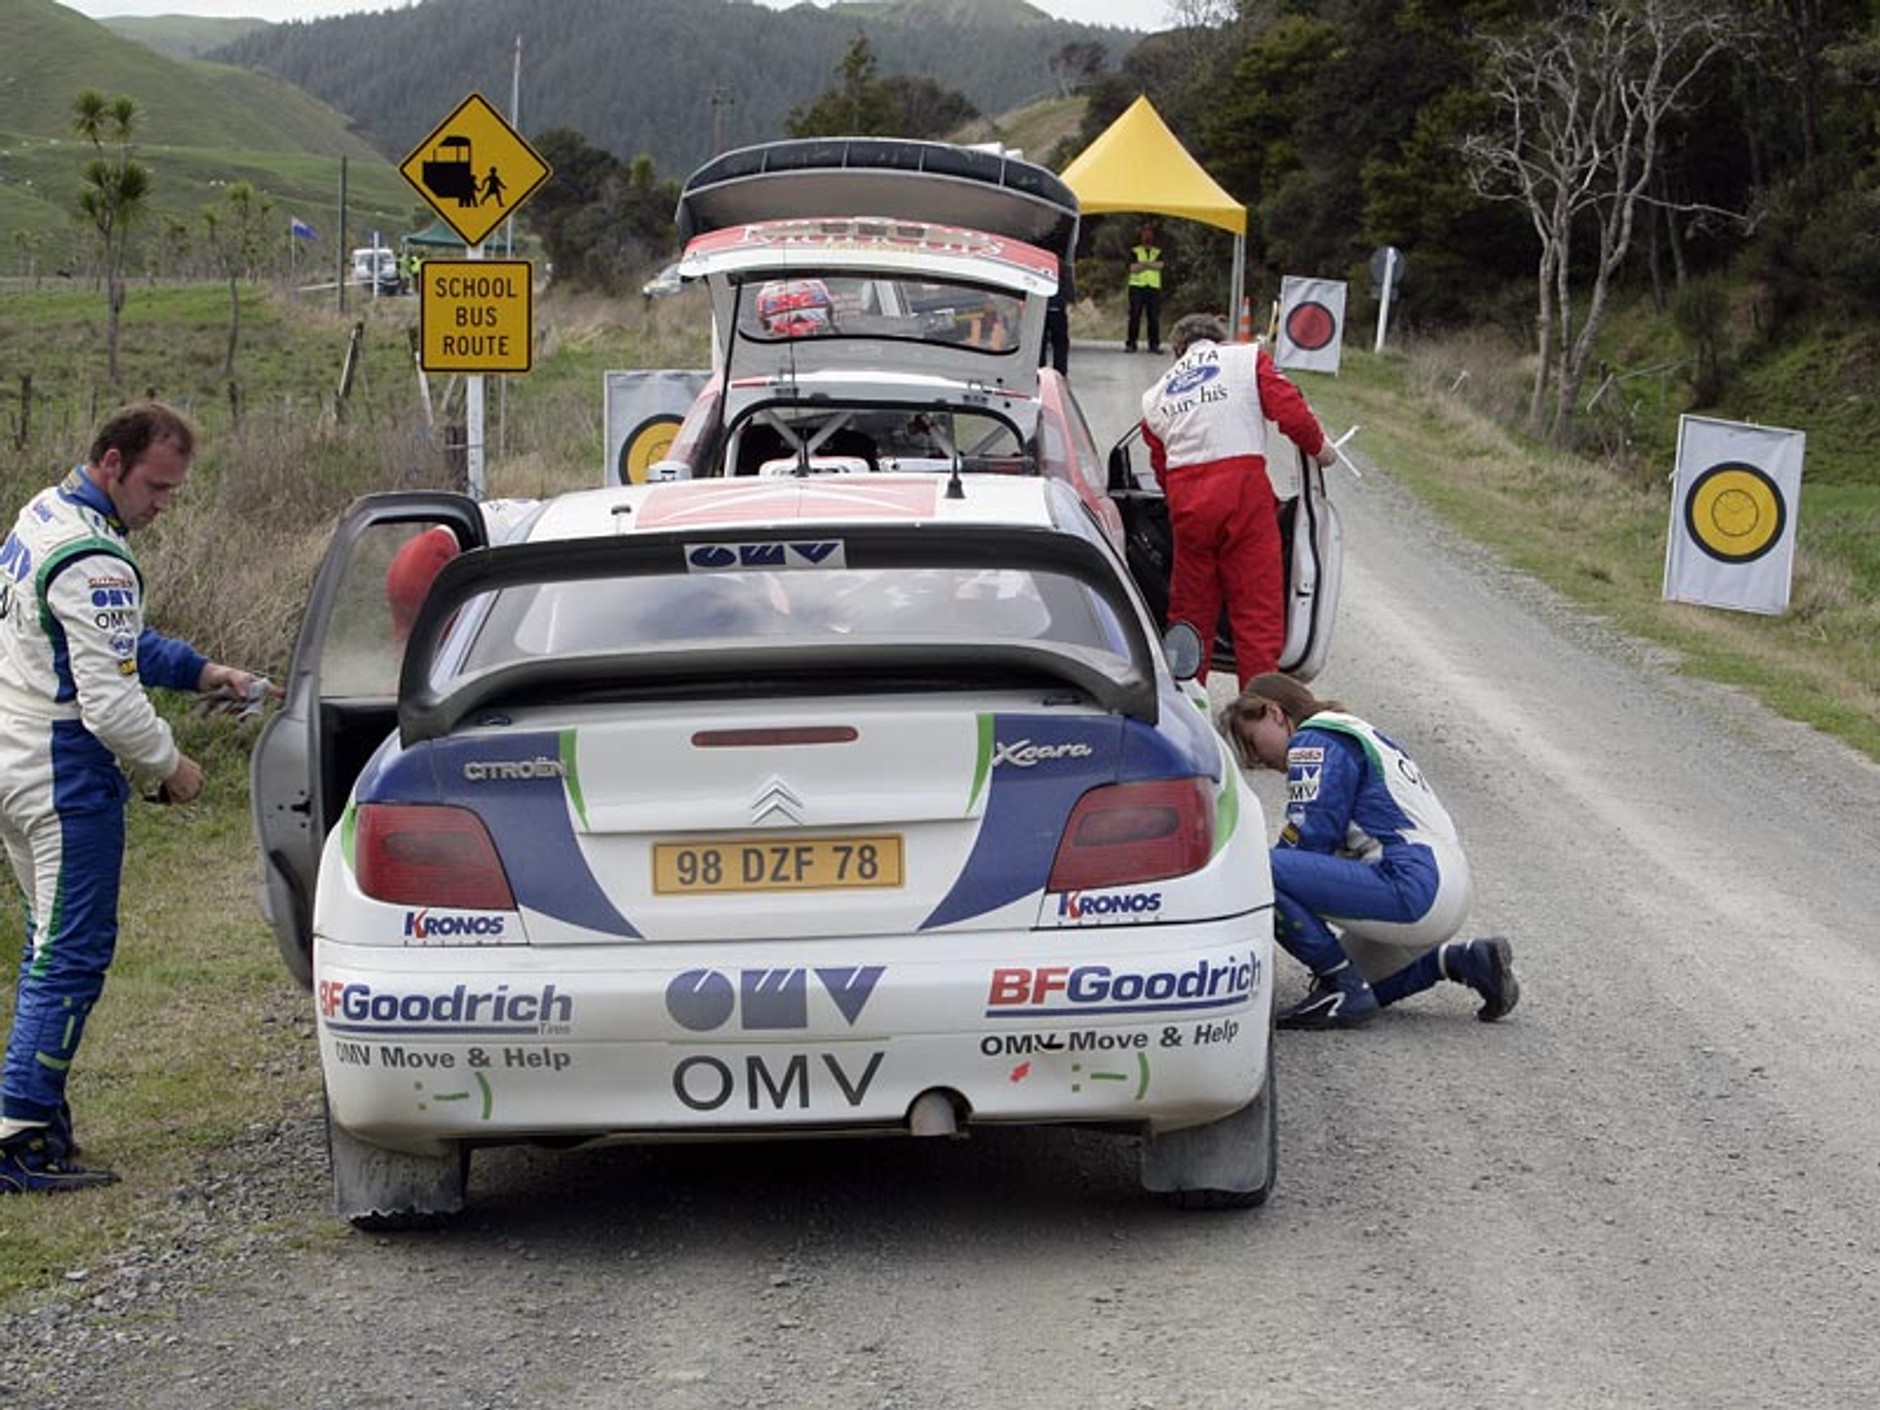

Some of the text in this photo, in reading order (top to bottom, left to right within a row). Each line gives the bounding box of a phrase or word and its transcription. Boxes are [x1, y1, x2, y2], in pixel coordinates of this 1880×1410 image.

[435, 277, 517, 298] SCHOOL
[455, 306, 498, 327] BUS
[443, 336, 509, 356] ROUTE
[464, 756, 567, 781] CITROËN
[676, 844, 878, 885] 98 DZF 78
[1058, 890, 1162, 919] KRONOS
[404, 909, 504, 938] KRONOS
[987, 950, 1261, 1007] BFGoodrich
[319, 980, 573, 1022] BFGoodrich
[664, 966, 887, 1032] OMV
[981, 1019, 1239, 1056] OMV Move & Help
[380, 1046, 455, 1068] Move
[467, 1047, 491, 1068] &
[504, 1048, 571, 1071] Help
[672, 1051, 886, 1111] OMV
